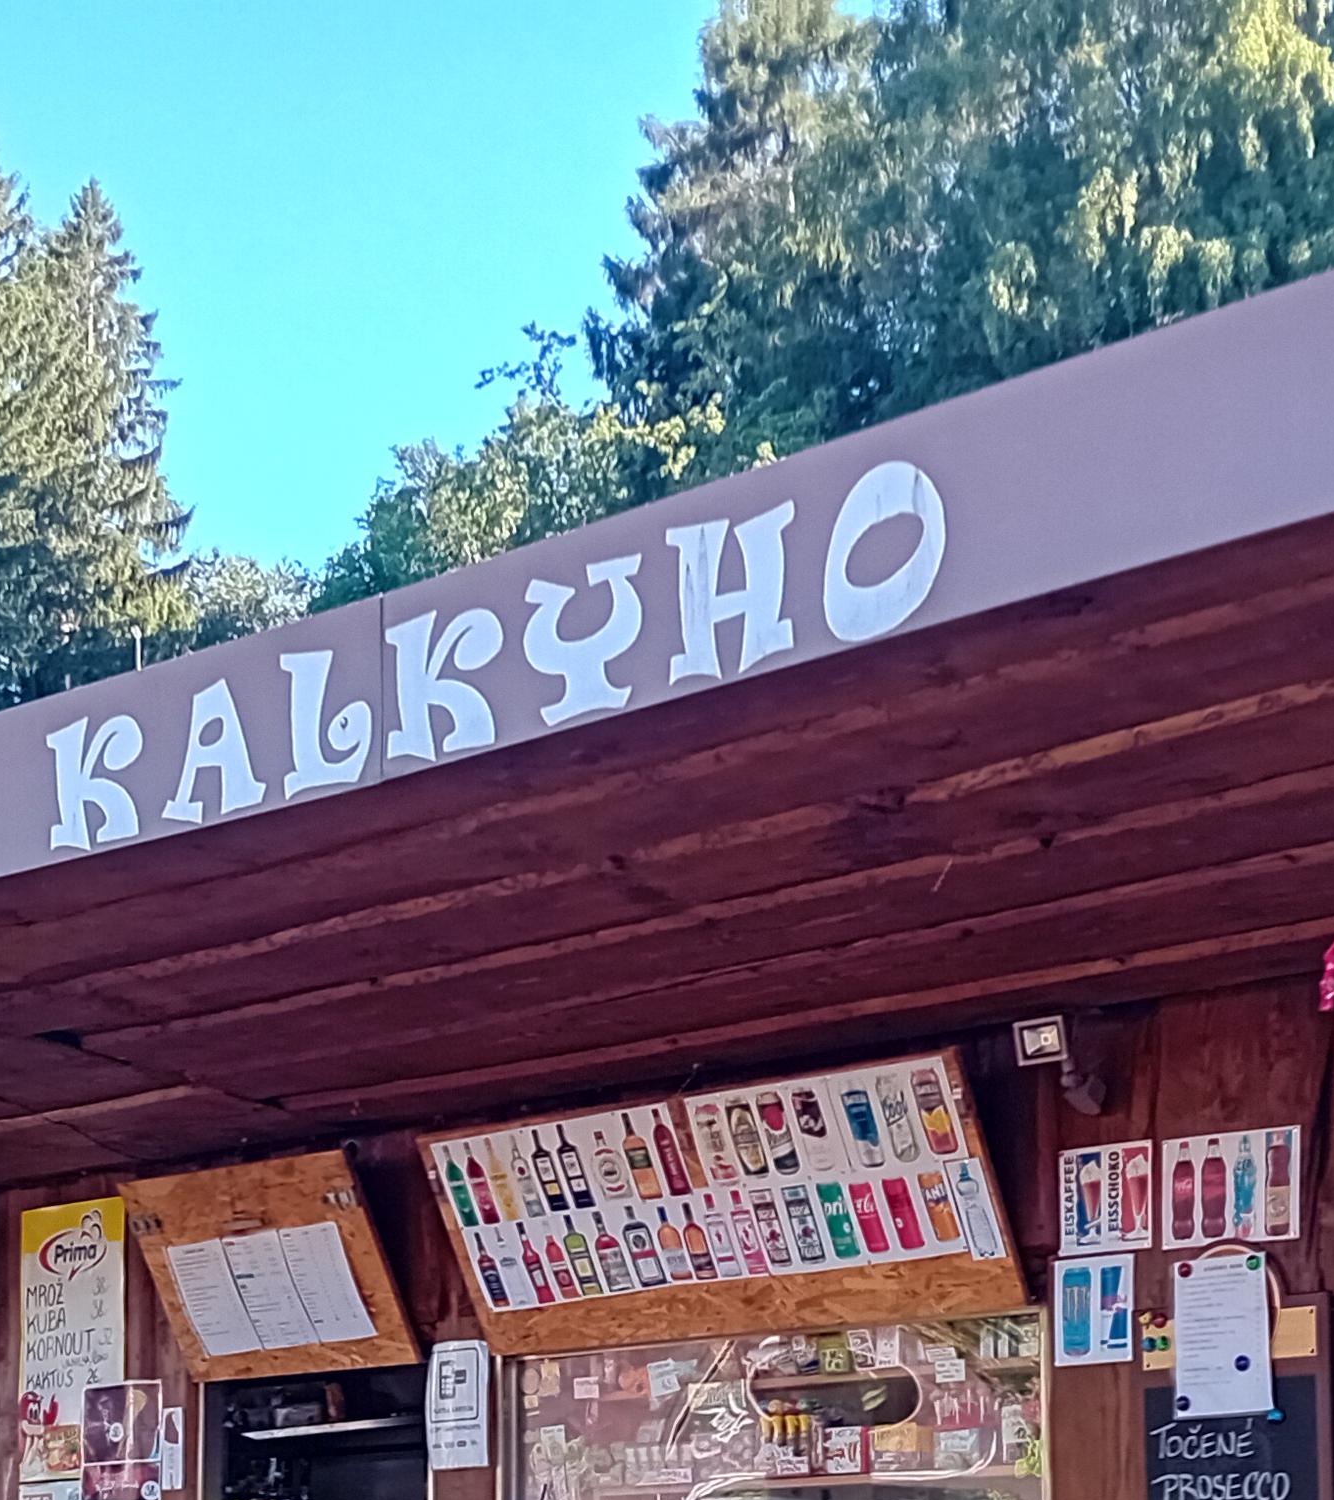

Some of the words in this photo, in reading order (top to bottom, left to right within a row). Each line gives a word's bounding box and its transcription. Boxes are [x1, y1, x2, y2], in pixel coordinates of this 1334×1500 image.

[46, 460, 946, 851] KALKYHO
[1063, 1154, 1075, 1236] EISKAFFEE
[1108, 1151, 1120, 1232] EISSCHOKO
[54, 1243, 97, 1265] Prima
[26, 1278, 64, 1309] MROŽ
[26, 1307, 66, 1335] KUBA
[1149, 1418, 1255, 1459] TOČENÉ
